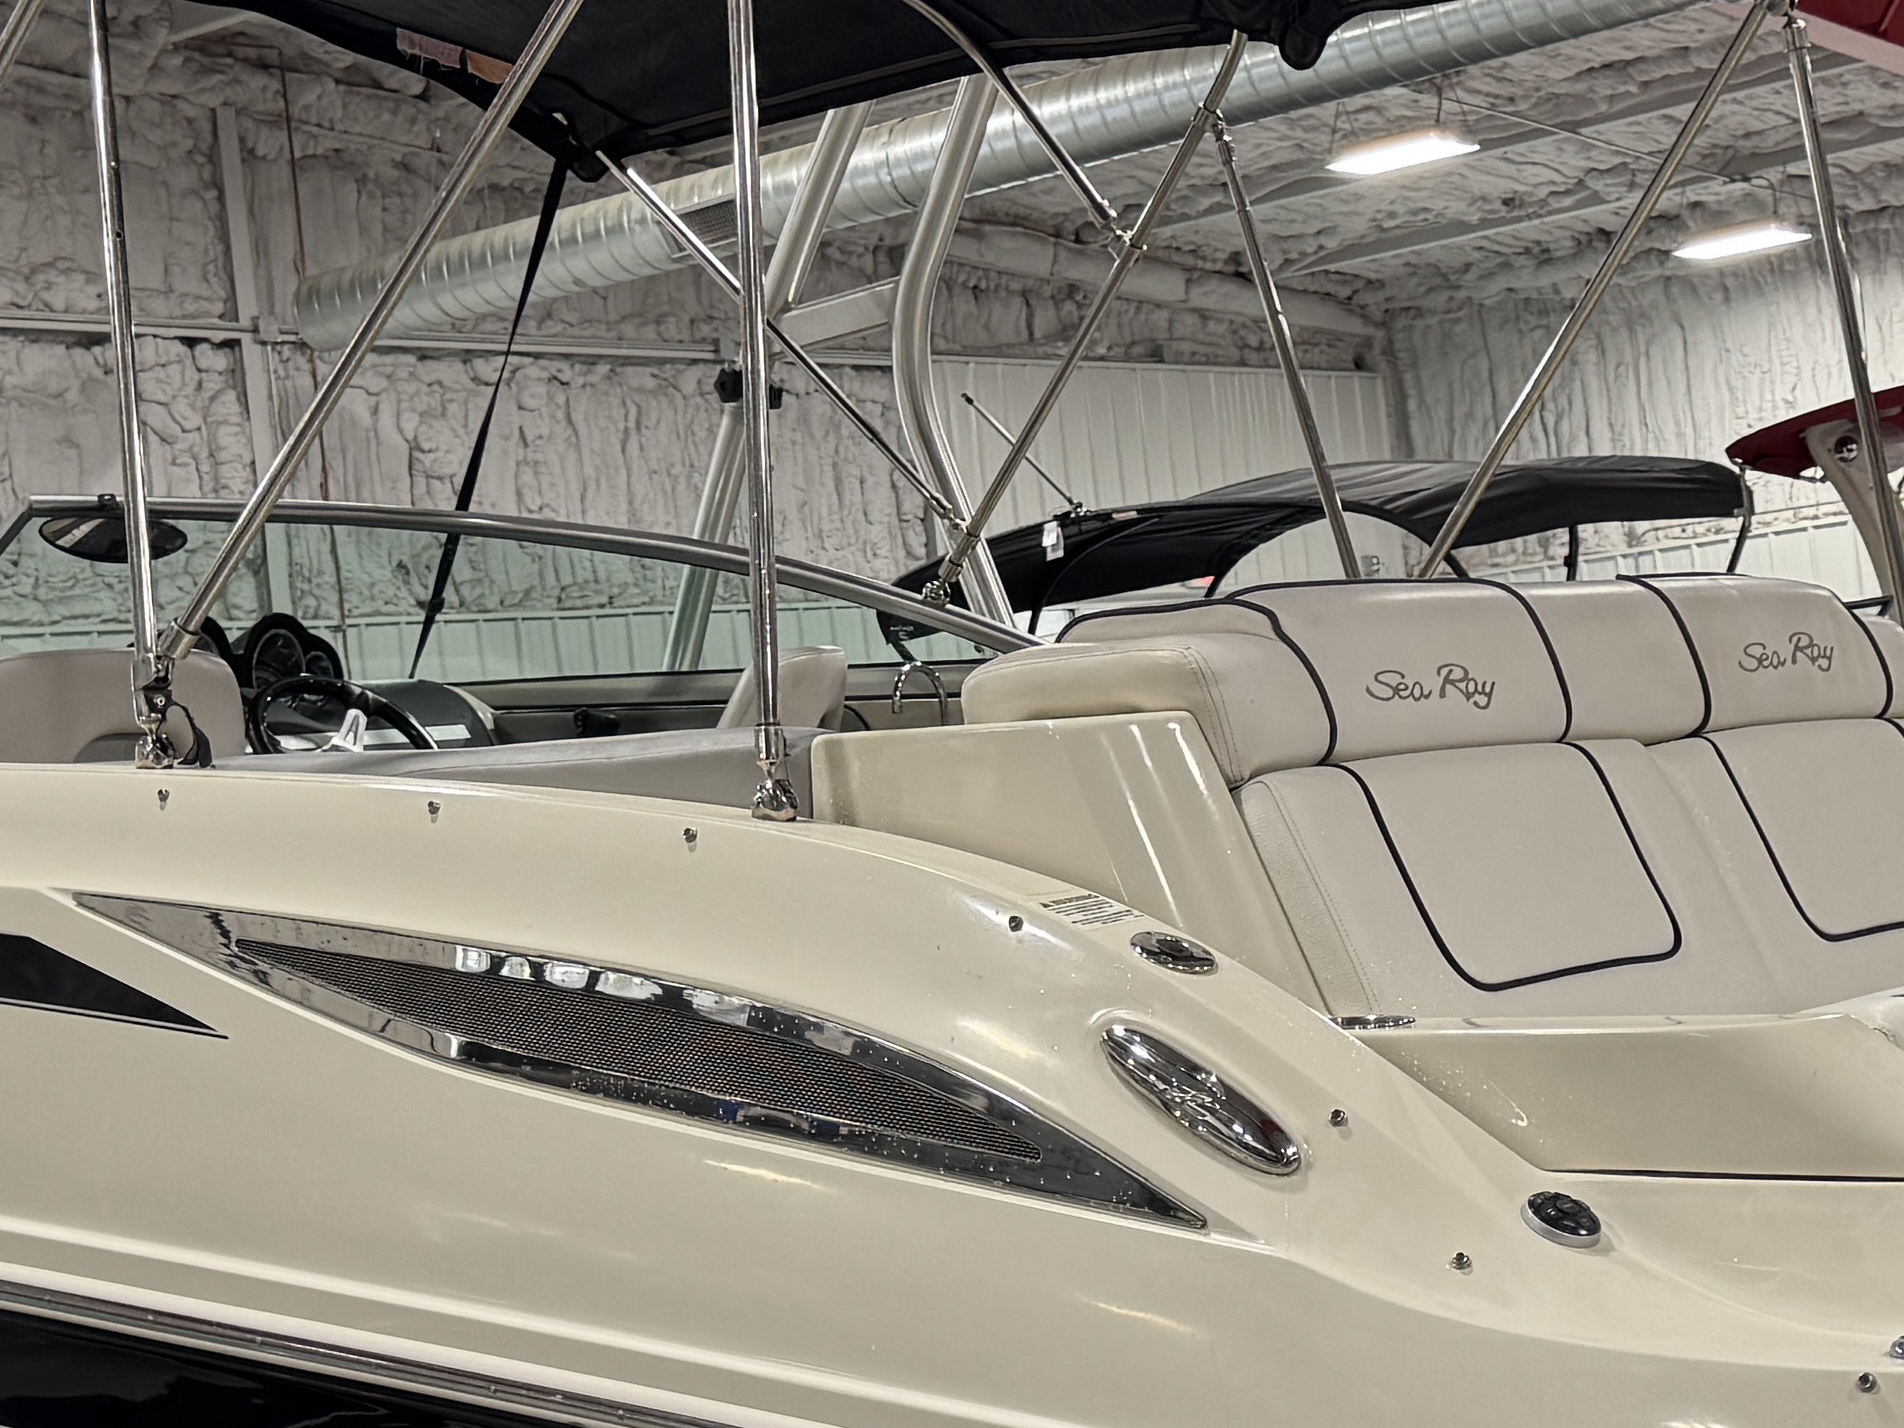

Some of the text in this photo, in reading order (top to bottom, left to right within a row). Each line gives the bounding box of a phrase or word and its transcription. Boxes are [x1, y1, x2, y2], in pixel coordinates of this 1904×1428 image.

[1738, 632, 1834, 672] Sea Ray
[1365, 663, 1495, 710] Sea Ray
